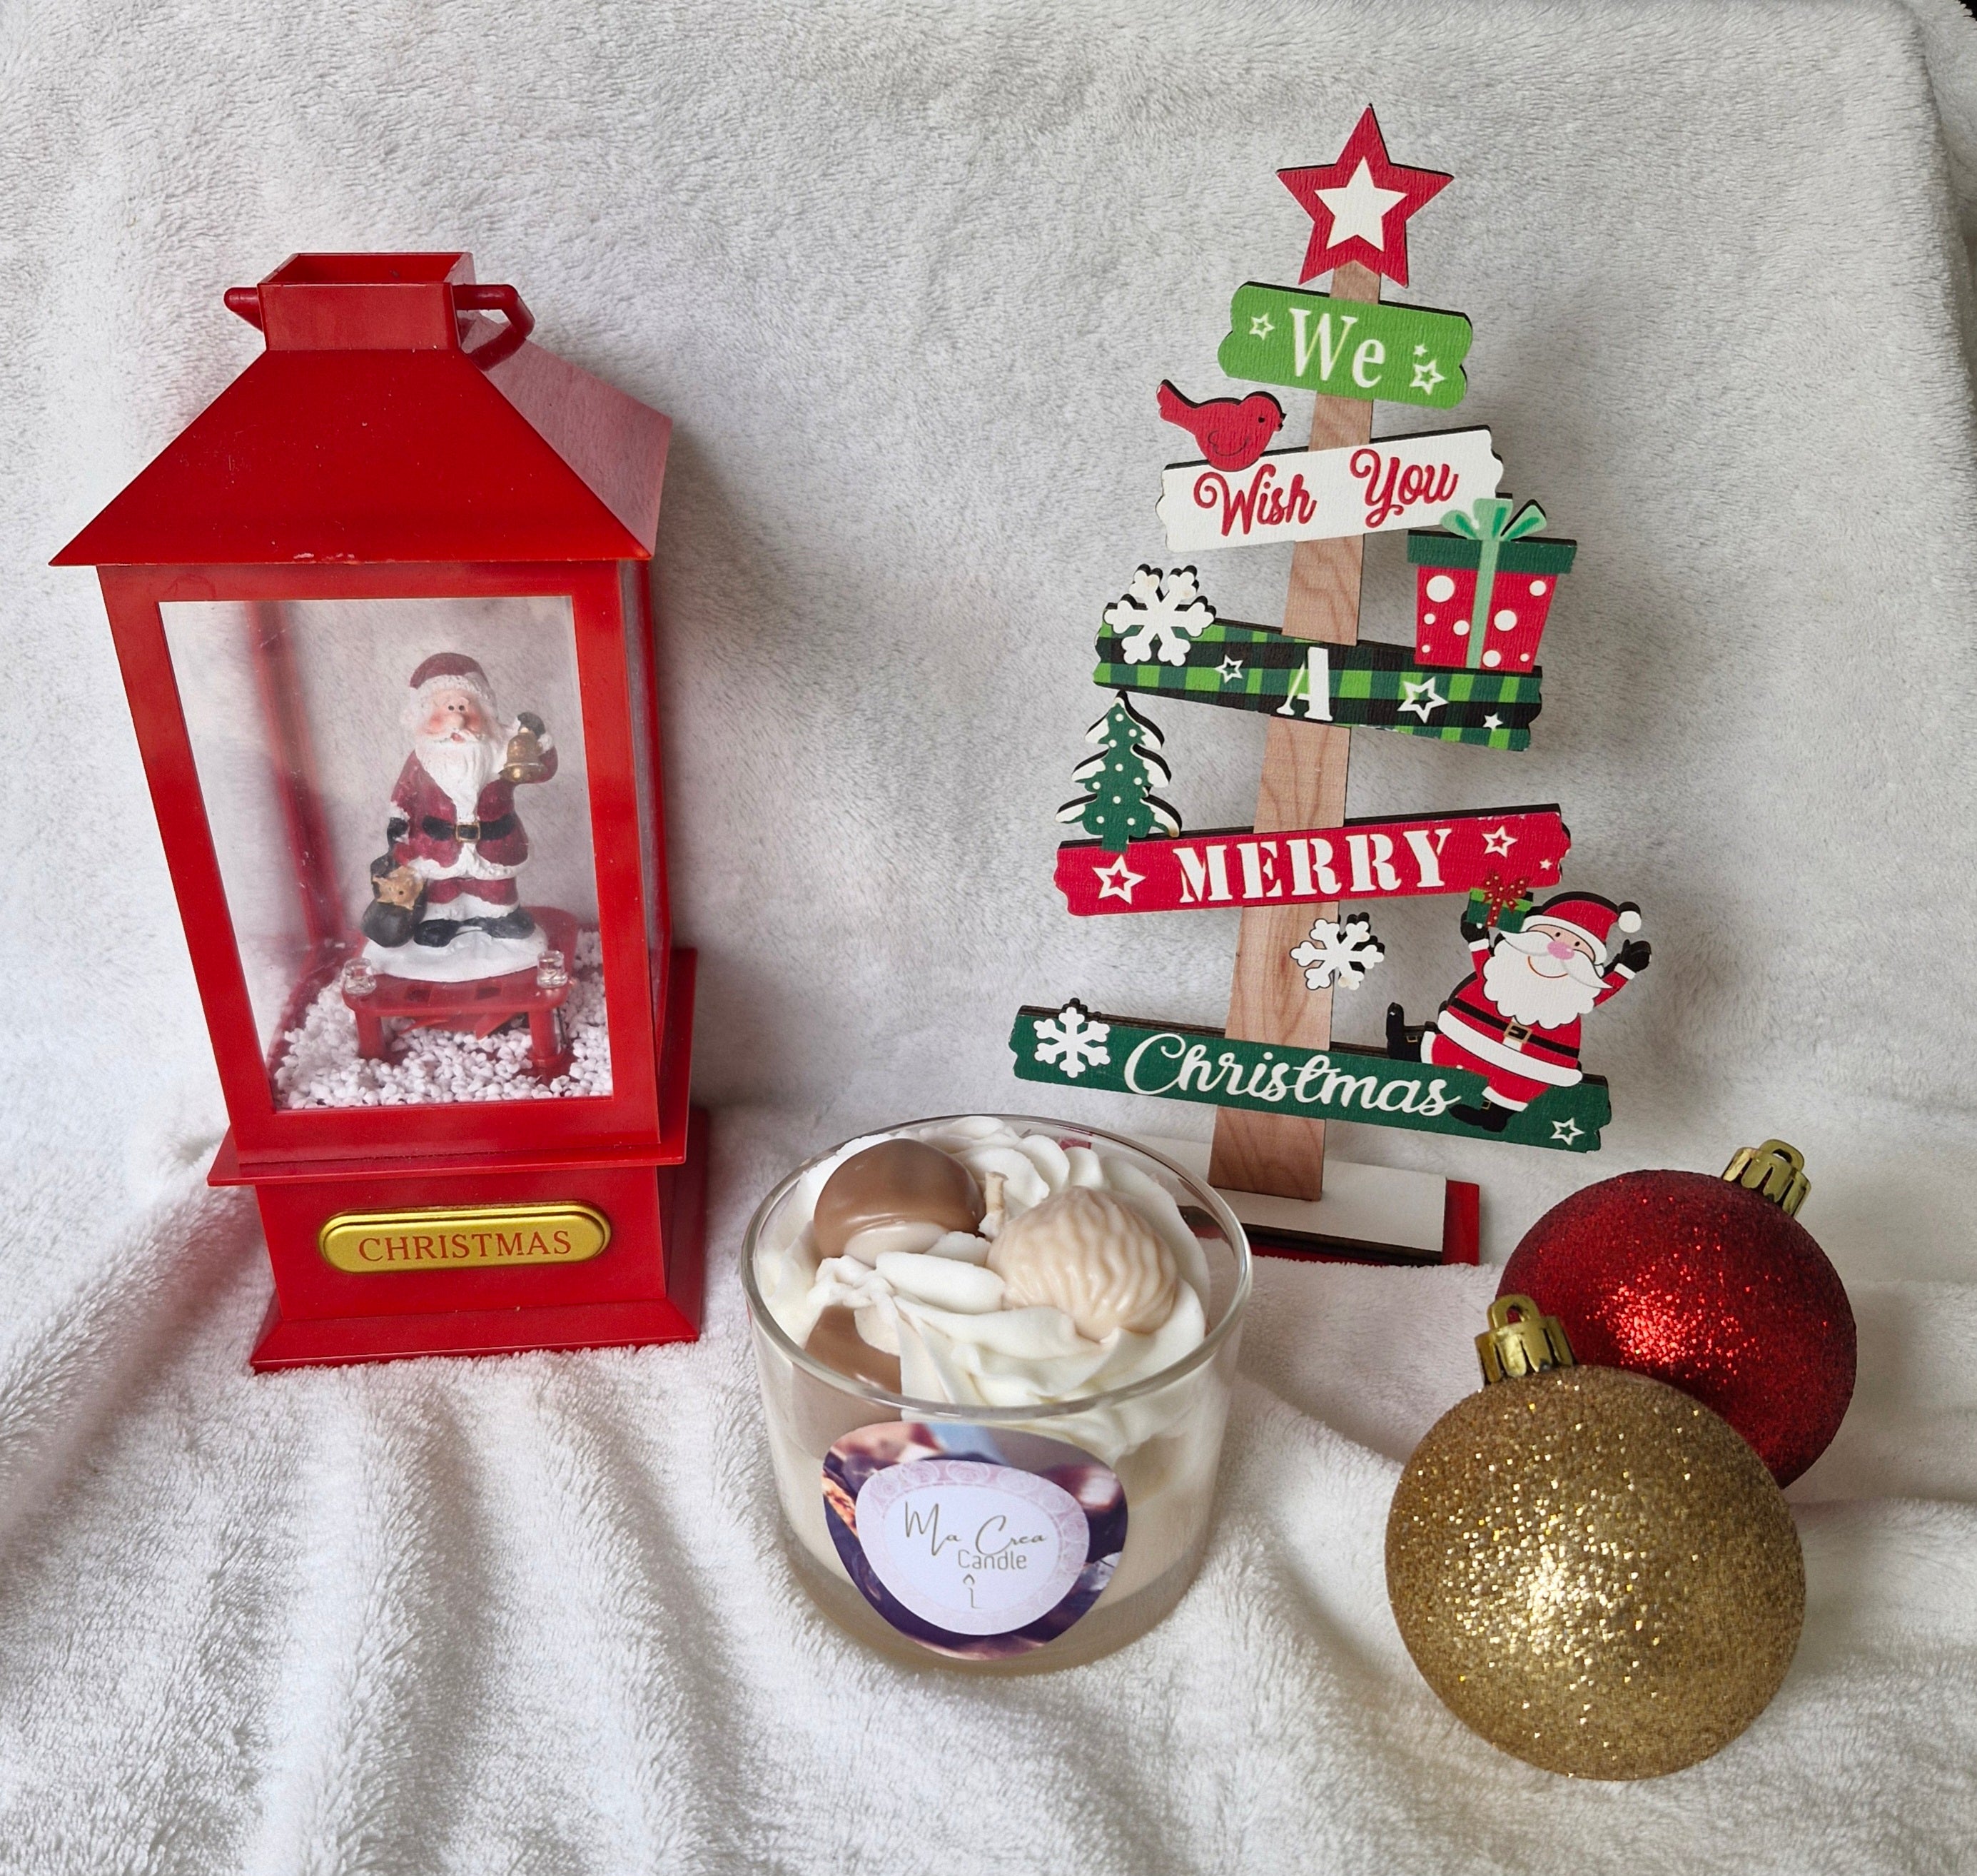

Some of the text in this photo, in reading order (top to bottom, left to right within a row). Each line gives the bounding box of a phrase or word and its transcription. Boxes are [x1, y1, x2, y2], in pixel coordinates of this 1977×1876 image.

[1289, 308, 1386, 388] We
[1193, 448, 1460, 537] Wish You
[1276, 646, 1333, 722] A
[1173, 828, 1452, 904] MERRY
[1123, 1032, 1462, 1116] Christmas
[358, 1230, 572, 1262] CHRISTMAS
[904, 1501, 1047, 1556] Ma Crea
[958, 1549, 1028, 1570] Candle
